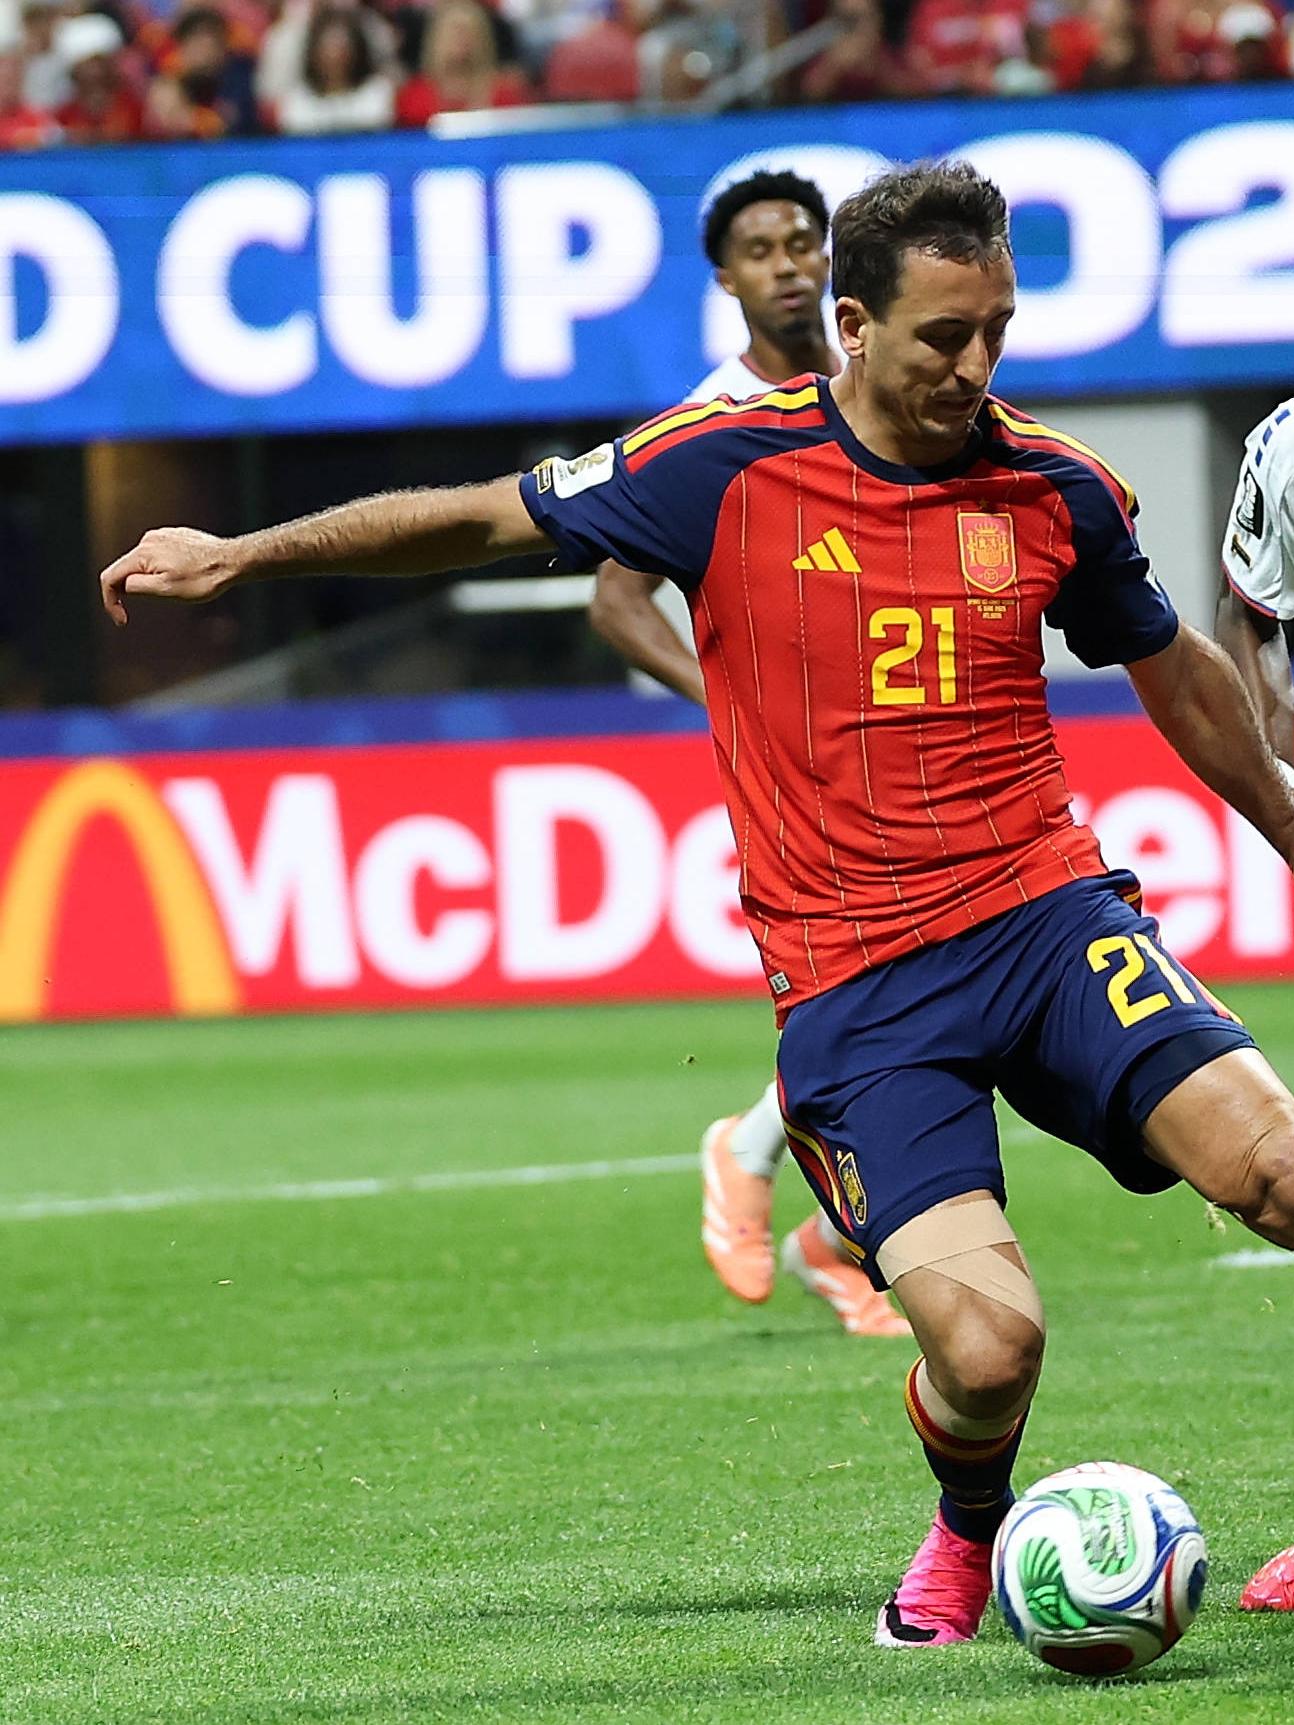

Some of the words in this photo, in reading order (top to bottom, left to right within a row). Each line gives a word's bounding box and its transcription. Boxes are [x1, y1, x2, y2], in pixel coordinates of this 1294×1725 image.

[157, 161, 662, 397] CUP
[868, 606, 957, 706] 21
[1087, 933, 1197, 1029] 21
